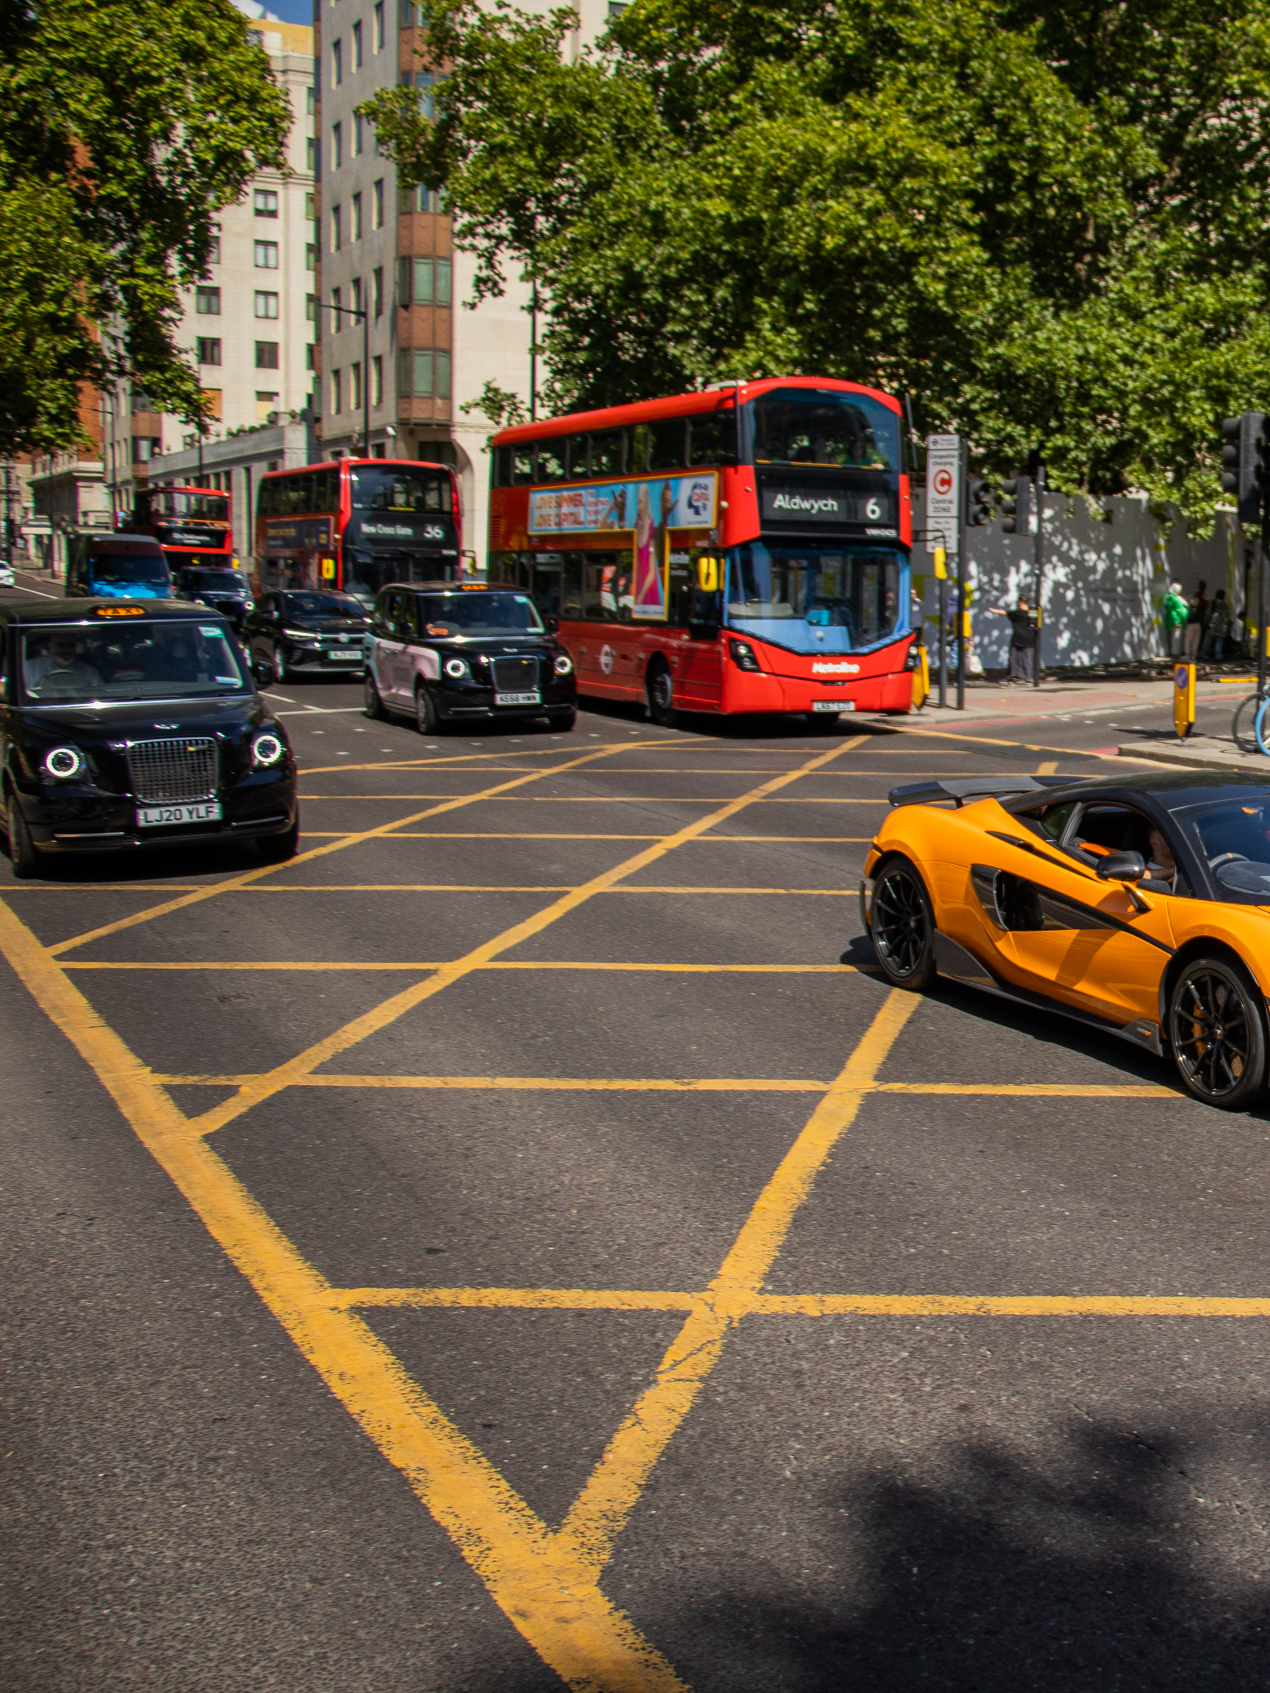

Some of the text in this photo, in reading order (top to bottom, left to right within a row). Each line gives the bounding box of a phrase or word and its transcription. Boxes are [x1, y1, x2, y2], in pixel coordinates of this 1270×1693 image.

[773, 494, 882, 520] Aldwych 6
[377, 524, 395, 534] Cross
[396, 525, 413, 535] Gate
[423, 524, 444, 538] 36
[102, 607, 144, 615] TAXI
[812, 661, 860, 673] Metroline
[143, 805, 214, 823] LJ20 YLF
